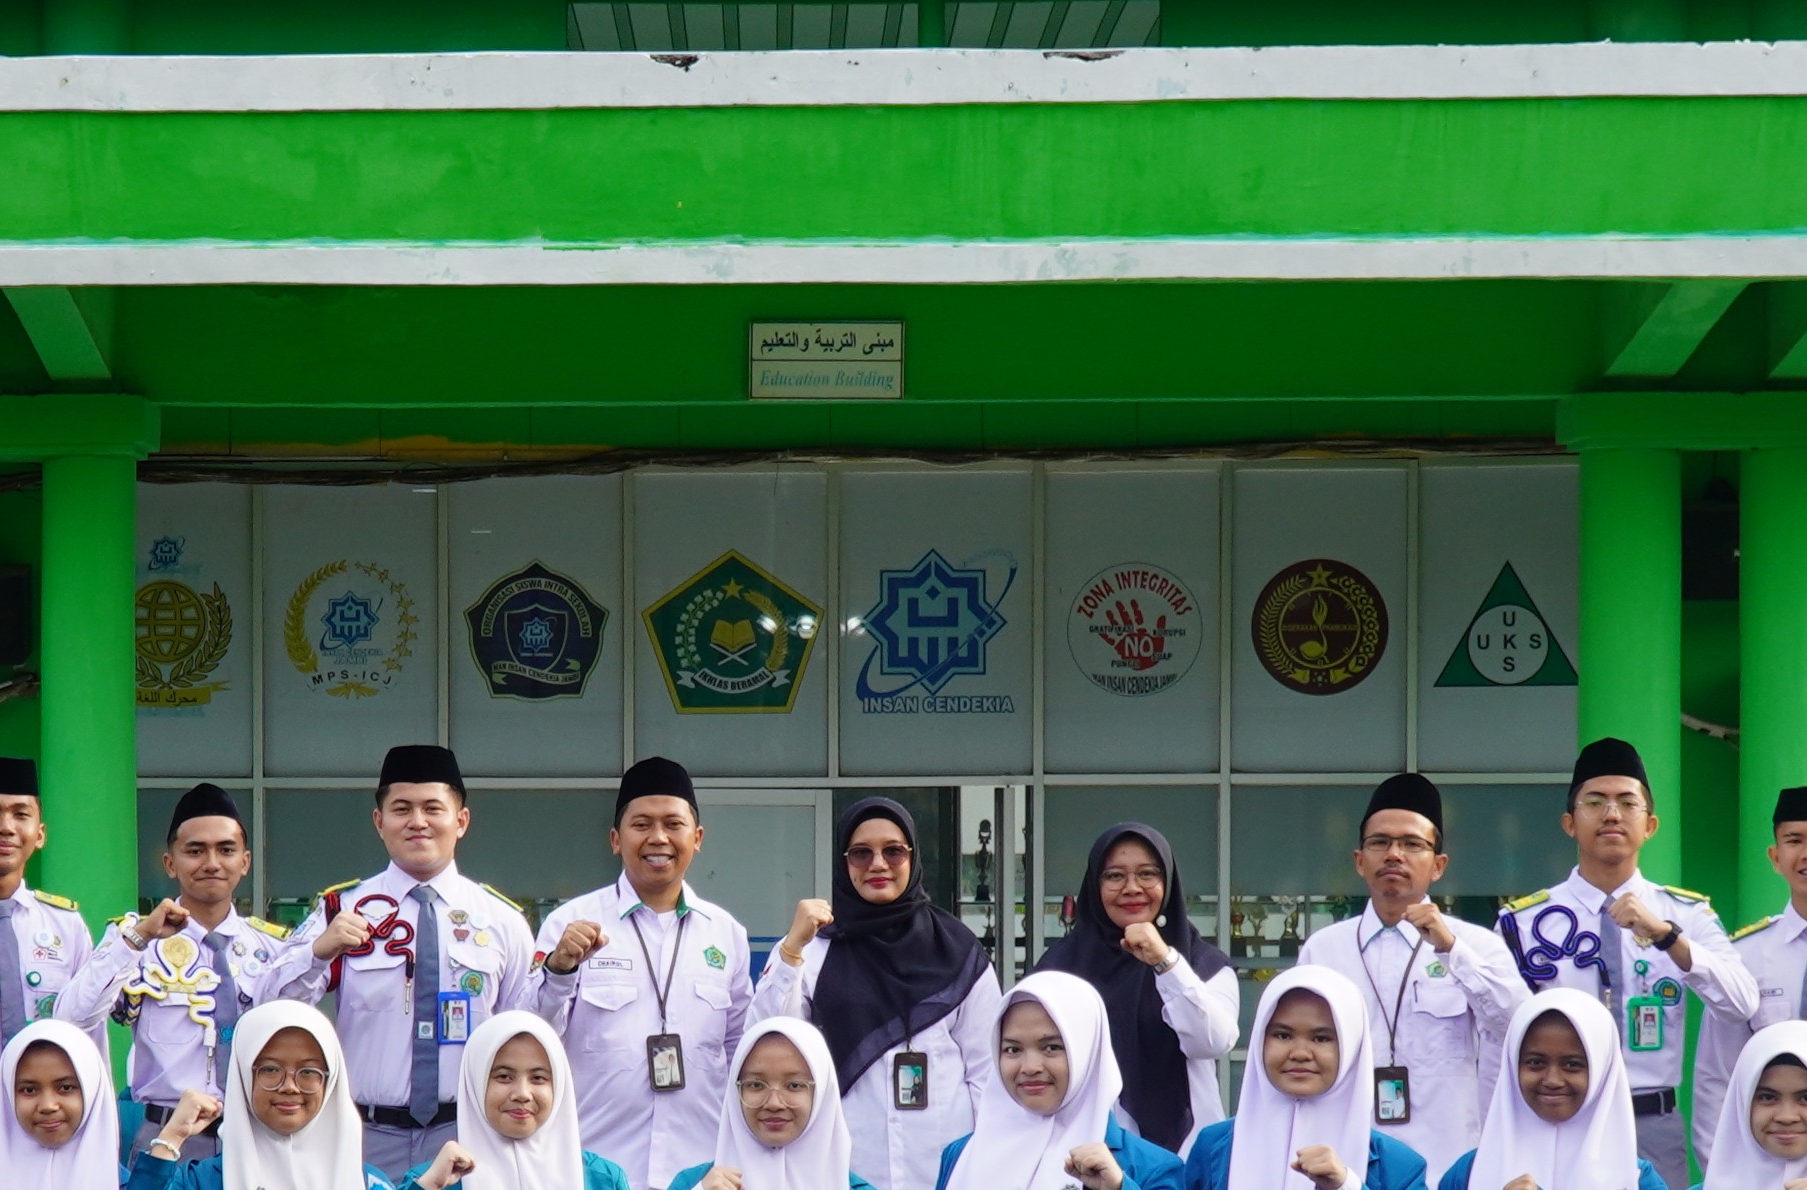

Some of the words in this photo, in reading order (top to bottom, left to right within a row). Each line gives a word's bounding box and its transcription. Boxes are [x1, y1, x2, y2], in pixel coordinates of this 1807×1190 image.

[760, 330, 810, 355] والتعليم
[814, 328, 857, 353] التربية
[862, 333, 895, 355] مبنى
[759, 369, 830, 387] Education
[835, 370, 895, 390] Building
[1077, 579, 1115, 620] ZONA
[1115, 570, 1192, 616] INTEGRITAS
[515, 579, 543, 592] SISWA
[544, 579, 569, 597] INTRA
[567, 593, 592, 637] SEKOLAH
[1124, 636, 1154, 658] NO
[698, 670, 729, 690] IKHLAS
[730, 669, 771, 691] BERAMAL
[862, 695, 919, 714] INSAN
[922, 695, 1015, 714] CENDEKIA
